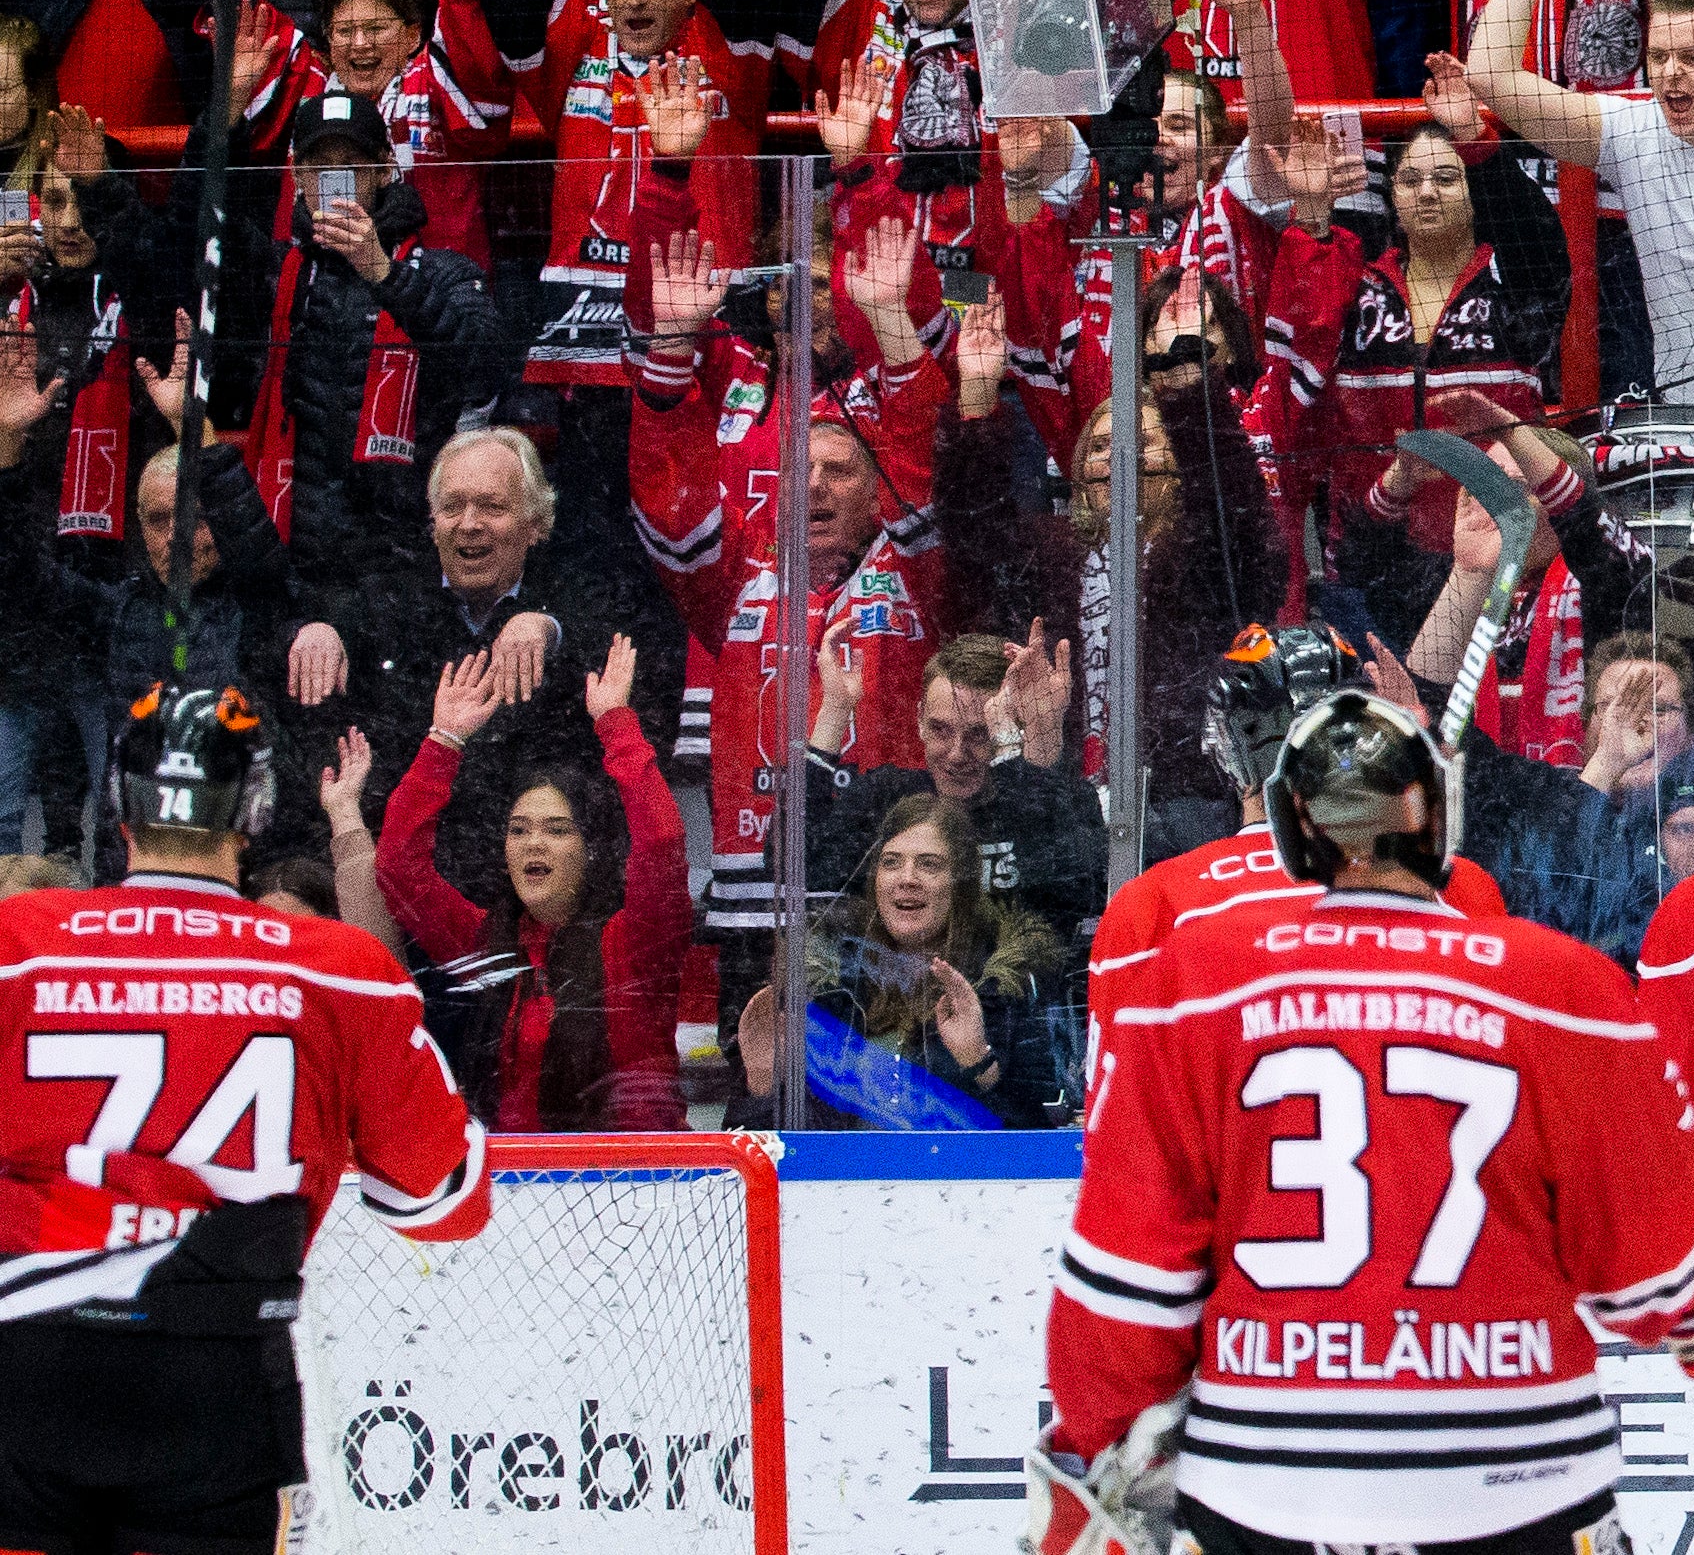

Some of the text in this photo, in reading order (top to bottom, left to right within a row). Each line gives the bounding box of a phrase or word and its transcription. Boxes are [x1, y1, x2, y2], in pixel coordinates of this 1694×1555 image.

[158, 786, 192, 822] 74
[62, 905, 291, 947] CONSTO
[1259, 923, 1505, 965] CONSTO
[34, 981, 304, 1019] MALMBERGS
[1240, 994, 1507, 1050] MALMBERGS
[26, 1031, 305, 1203] 74
[1233, 1044, 1519, 1290] 37
[1215, 1309, 1556, 1381] KILPELÄINEN
